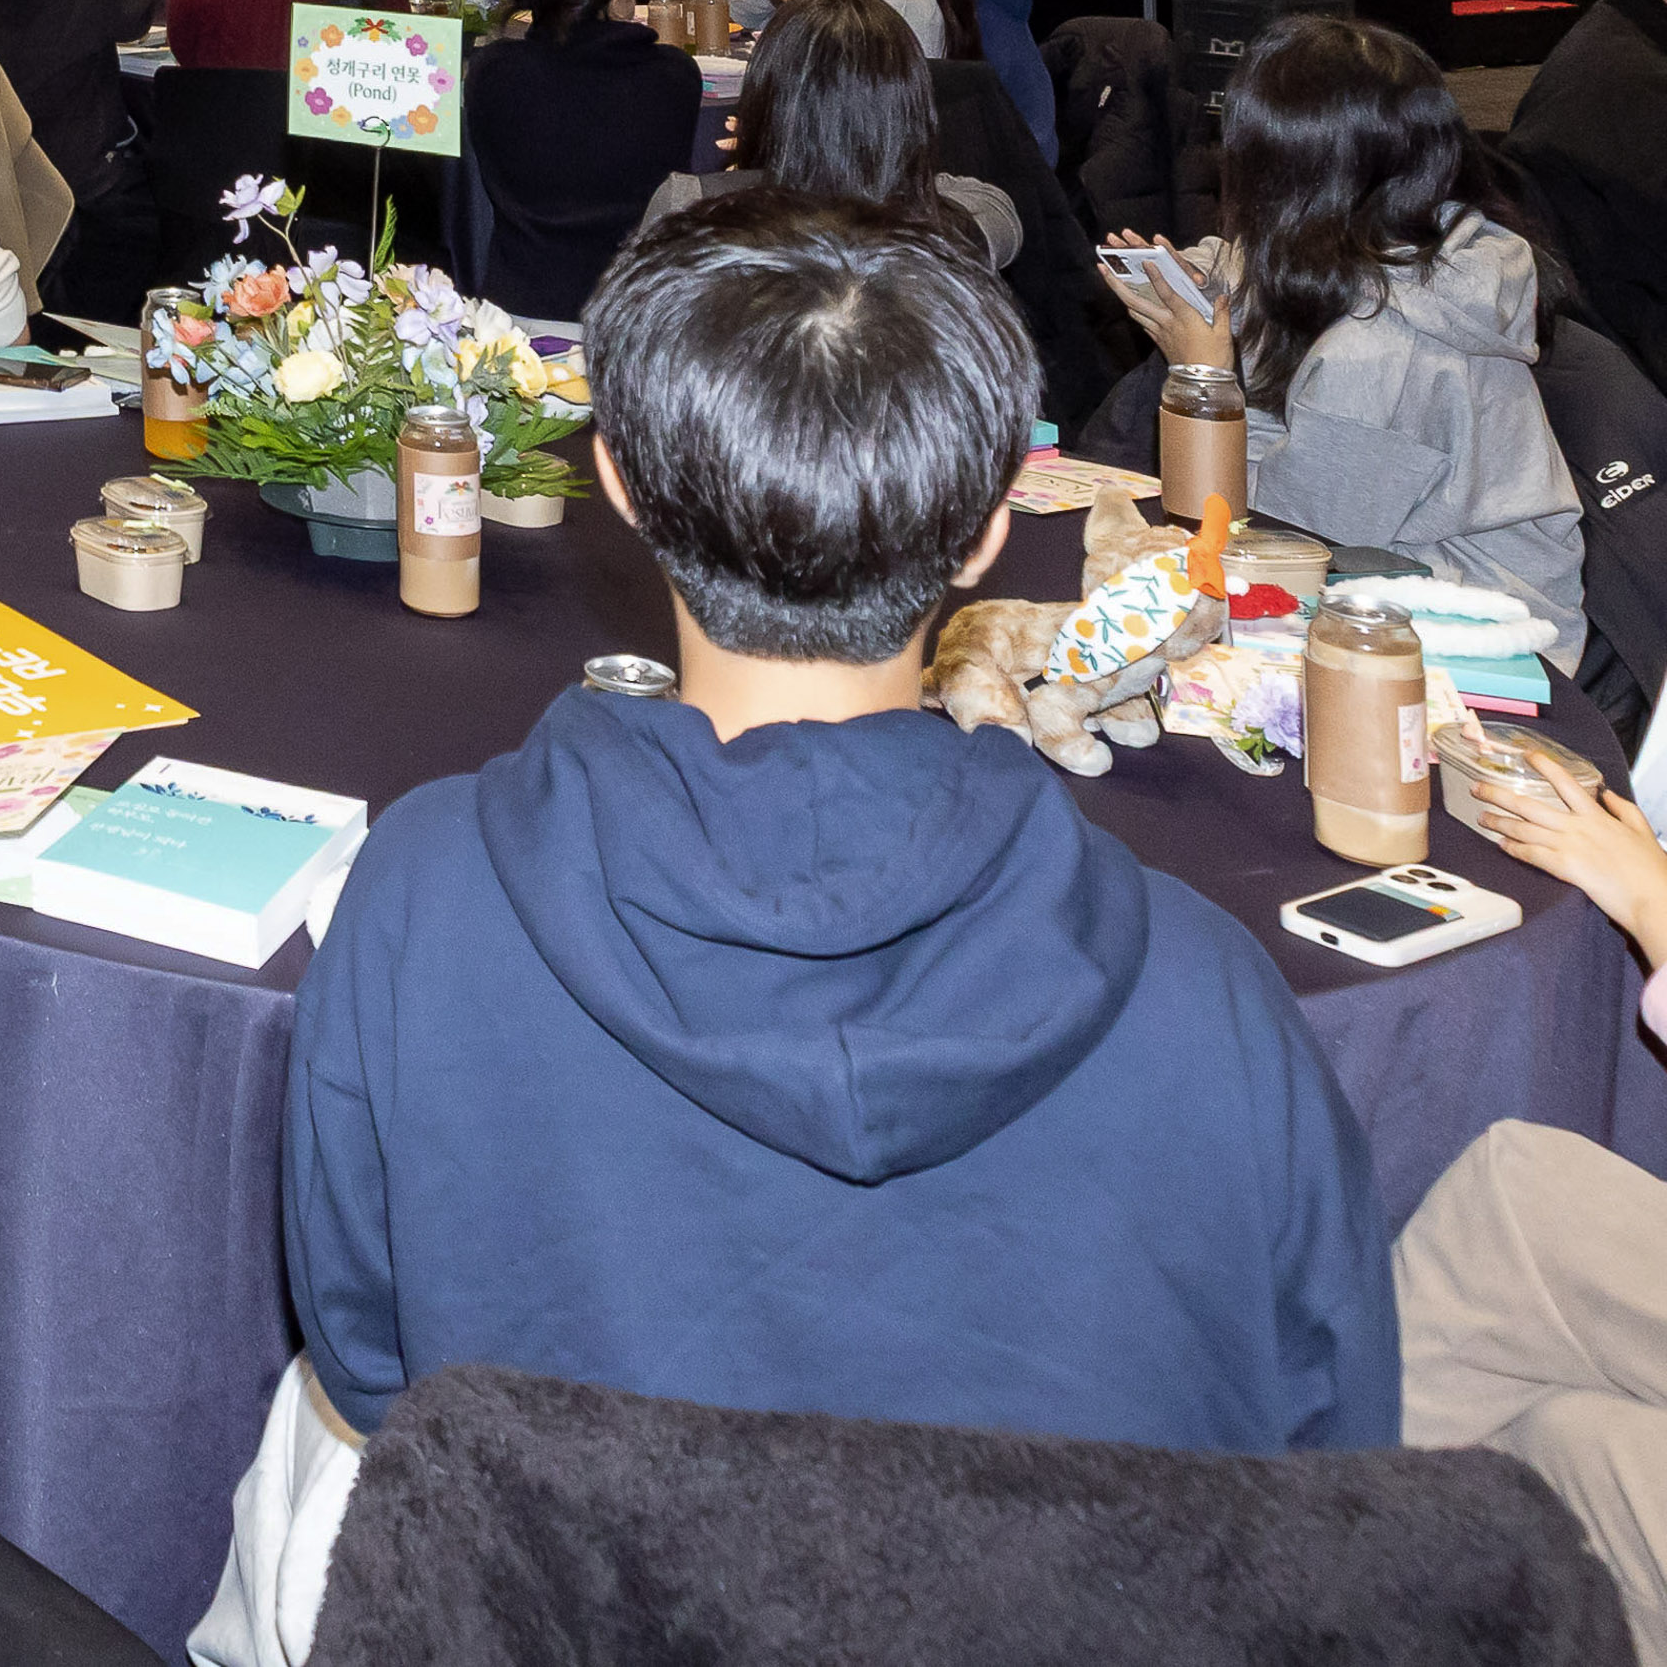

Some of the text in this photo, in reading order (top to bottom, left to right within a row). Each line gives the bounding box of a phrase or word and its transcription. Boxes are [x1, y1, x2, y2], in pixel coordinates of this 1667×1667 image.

[326, 57, 422, 84] 청개구리 연못
[348, 82, 398, 103] (Pond)
